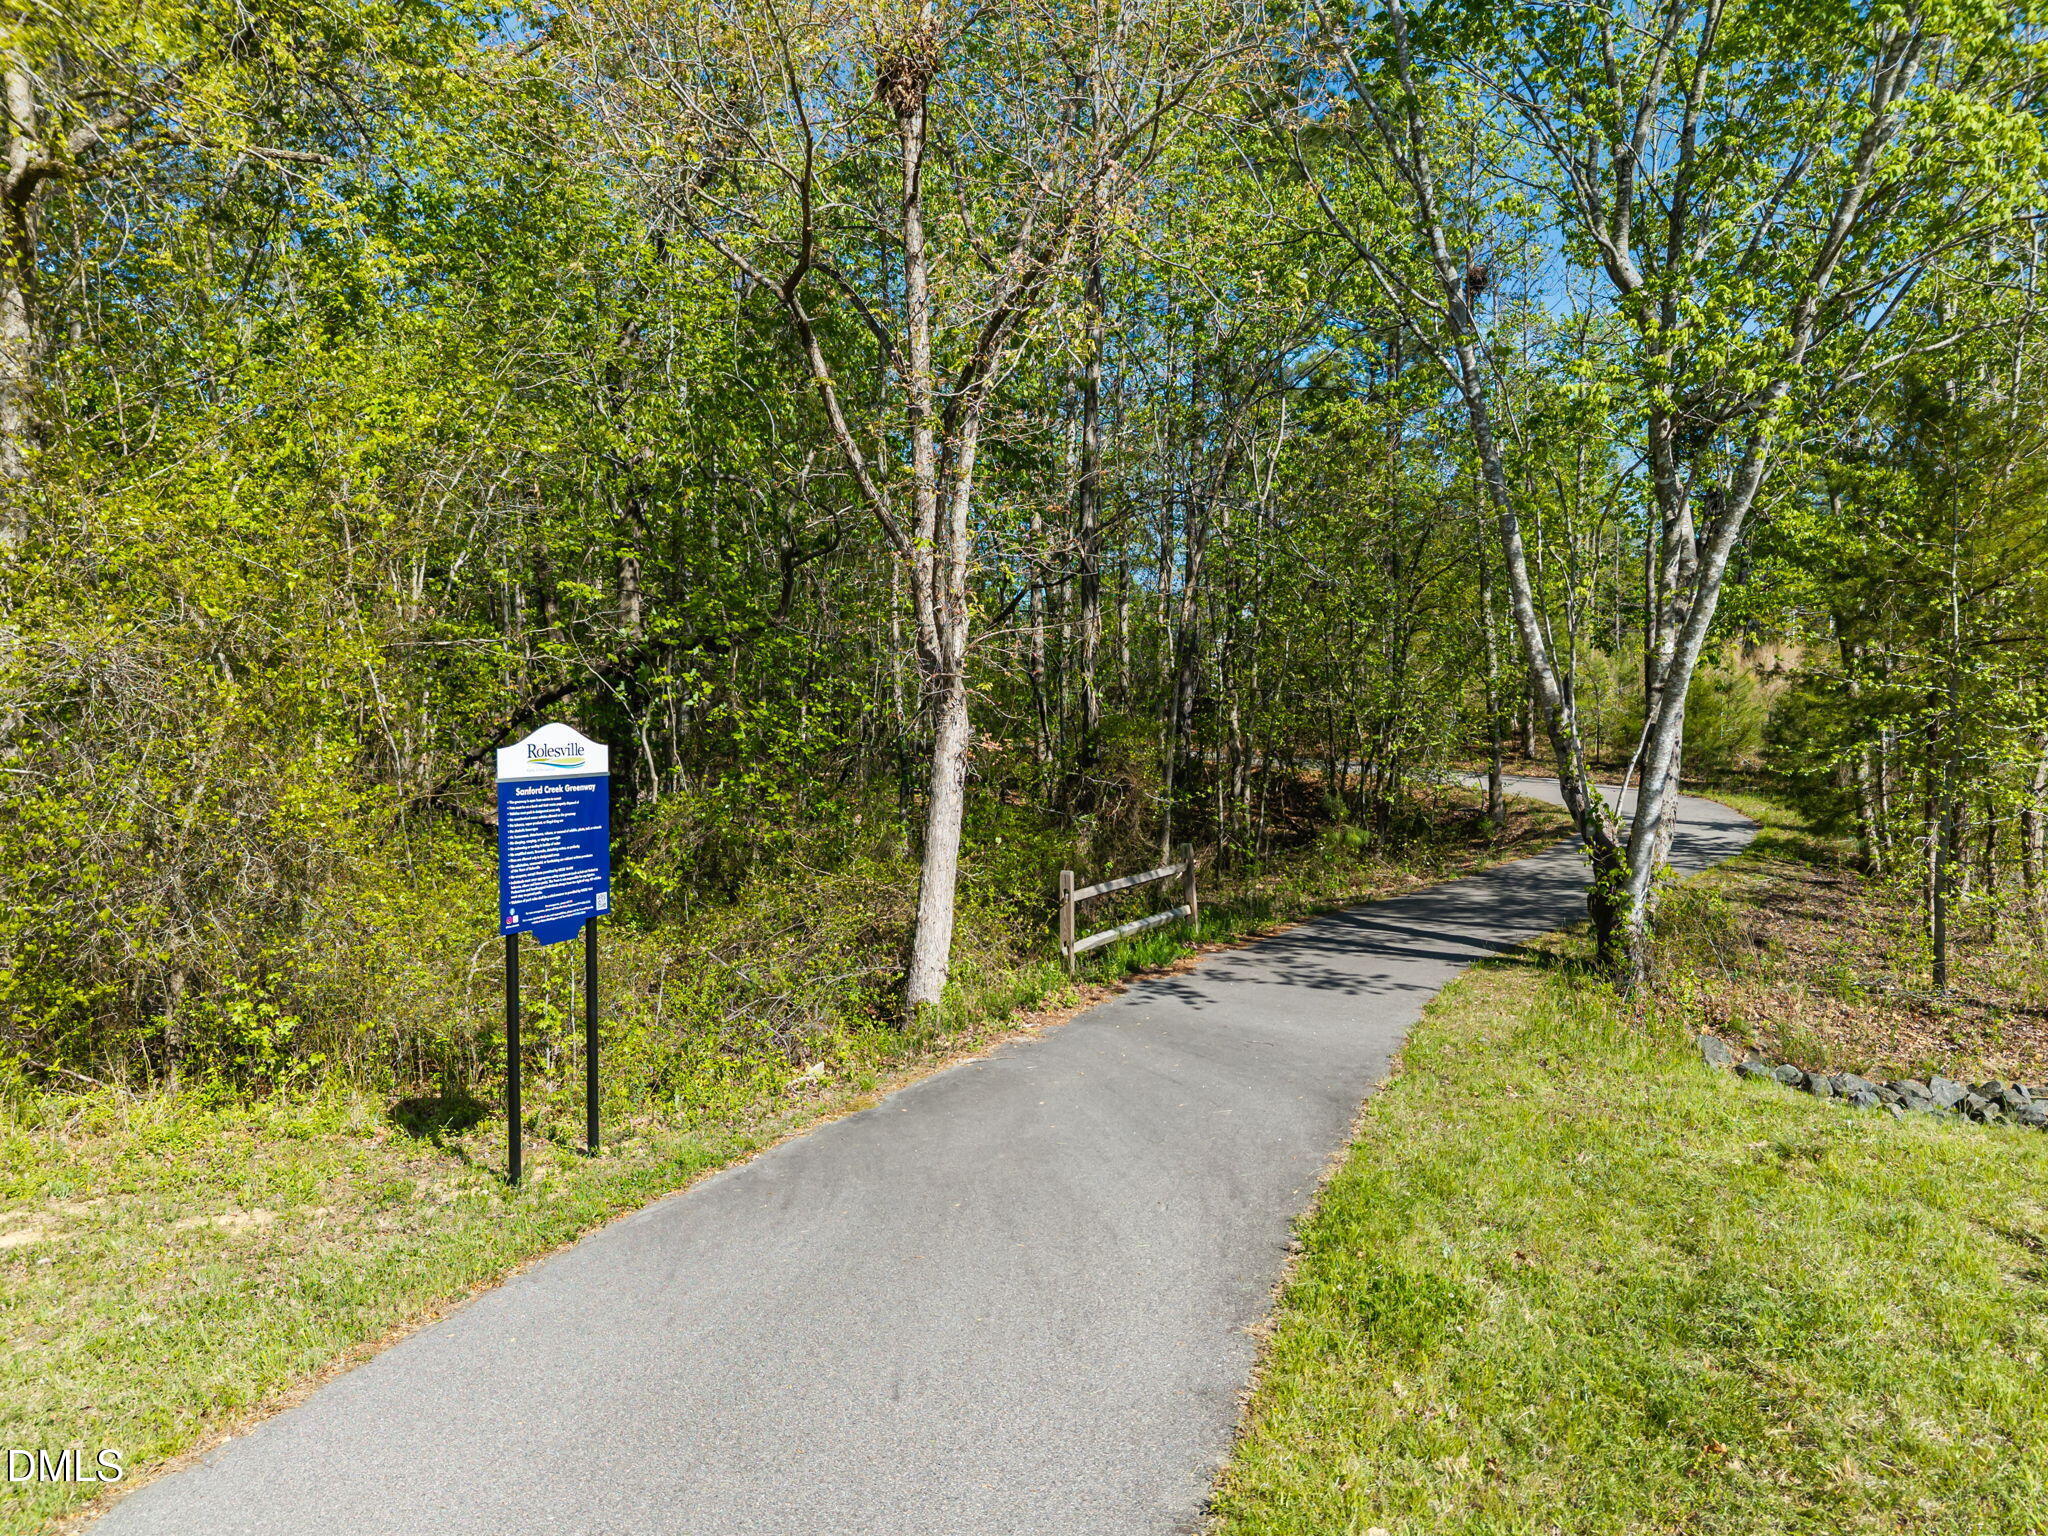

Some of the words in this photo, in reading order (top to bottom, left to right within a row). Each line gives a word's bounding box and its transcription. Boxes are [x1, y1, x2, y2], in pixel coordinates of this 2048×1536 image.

[527, 743, 585, 759] Rolesville
[515, 786, 543, 796] Sanford
[544, 784, 564, 794] Creek
[564, 783, 596, 792] Greenway
